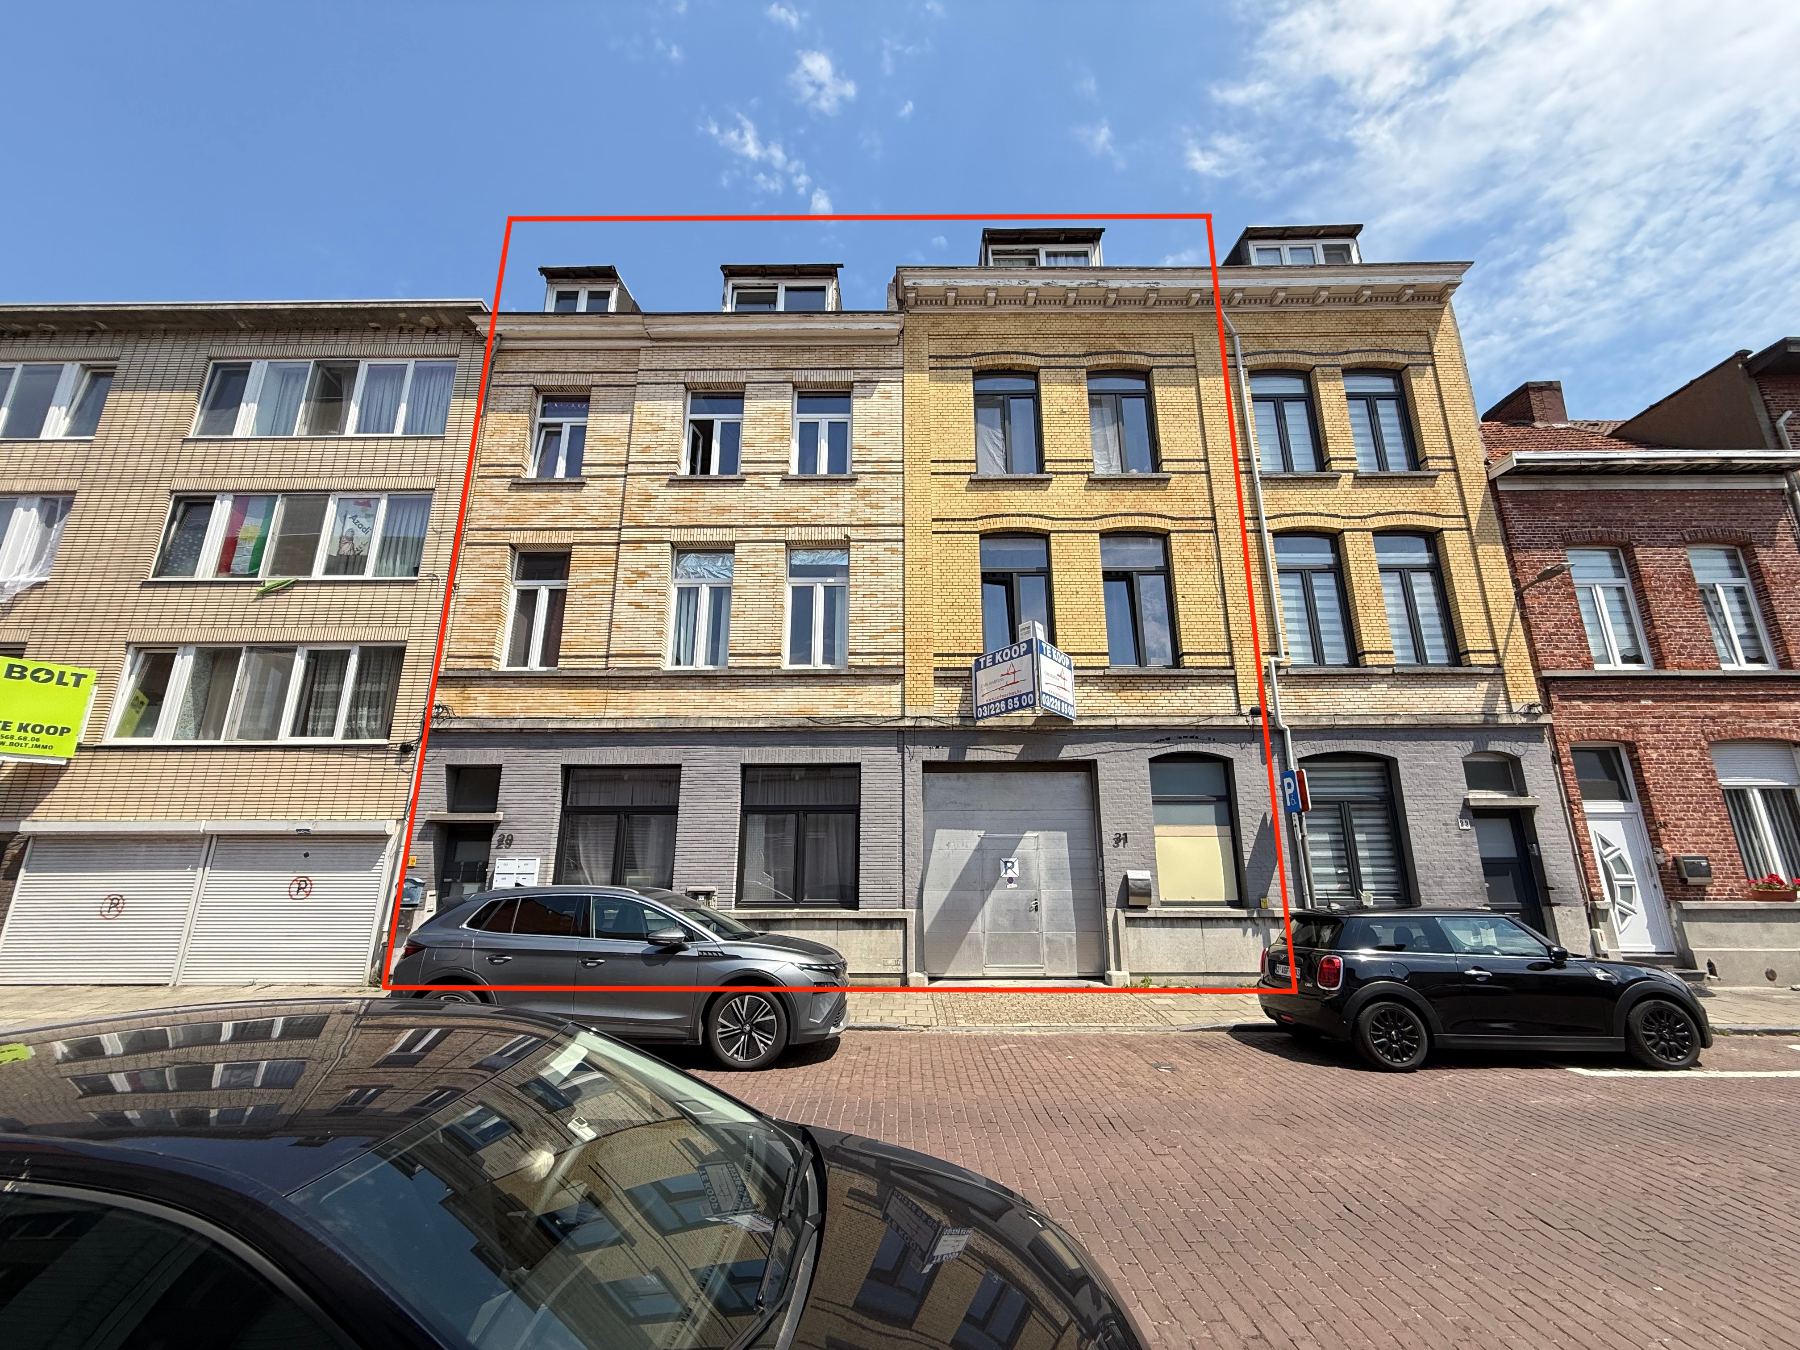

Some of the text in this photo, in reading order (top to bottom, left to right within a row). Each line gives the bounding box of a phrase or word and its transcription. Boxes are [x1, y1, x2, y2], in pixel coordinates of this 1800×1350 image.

[979, 643, 1028, 669] TE KOOP
[1041, 642, 1070, 668] TE KOOP
[4, 663, 88, 688] BOLT
[977, 701, 1006, 717] 03/226
[1007, 697, 1020, 709] 85
[1021, 693, 1034, 706] 00
[17, 722, 71, 736] KOOP
[1283, 777, 1295, 806] P
[497, 833, 513, 848] 29
[1113, 832, 1128, 848] 31
